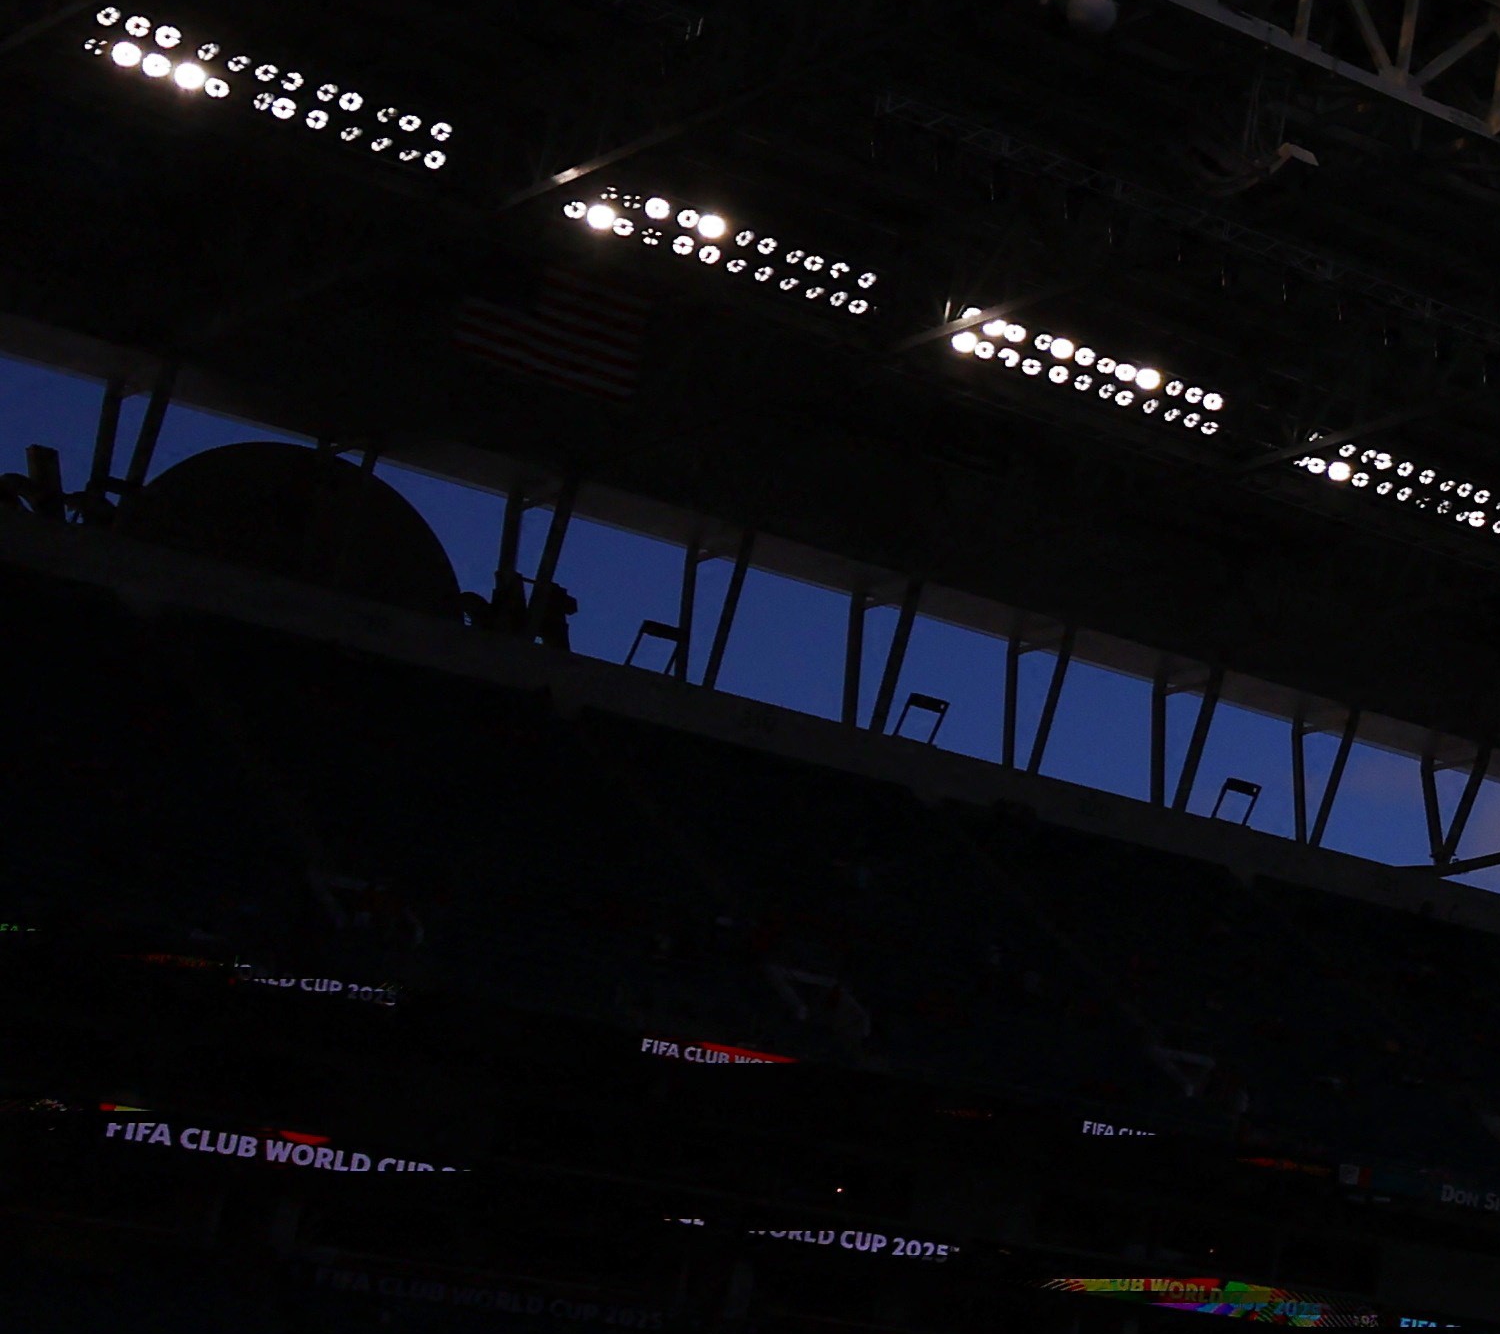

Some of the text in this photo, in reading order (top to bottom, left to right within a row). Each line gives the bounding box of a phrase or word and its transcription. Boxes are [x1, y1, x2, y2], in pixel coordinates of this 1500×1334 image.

[640, 1037, 680, 1059] FIFA
[1081, 1120, 1116, 1137] FIFA
[105, 1120, 173, 1149] FIFA
[179, 1127, 258, 1158] CLUB
[264, 1138, 372, 1173] WORLD
[1441, 1183, 1482, 1208] DON
[839, 1230, 888, 1253] CUP
